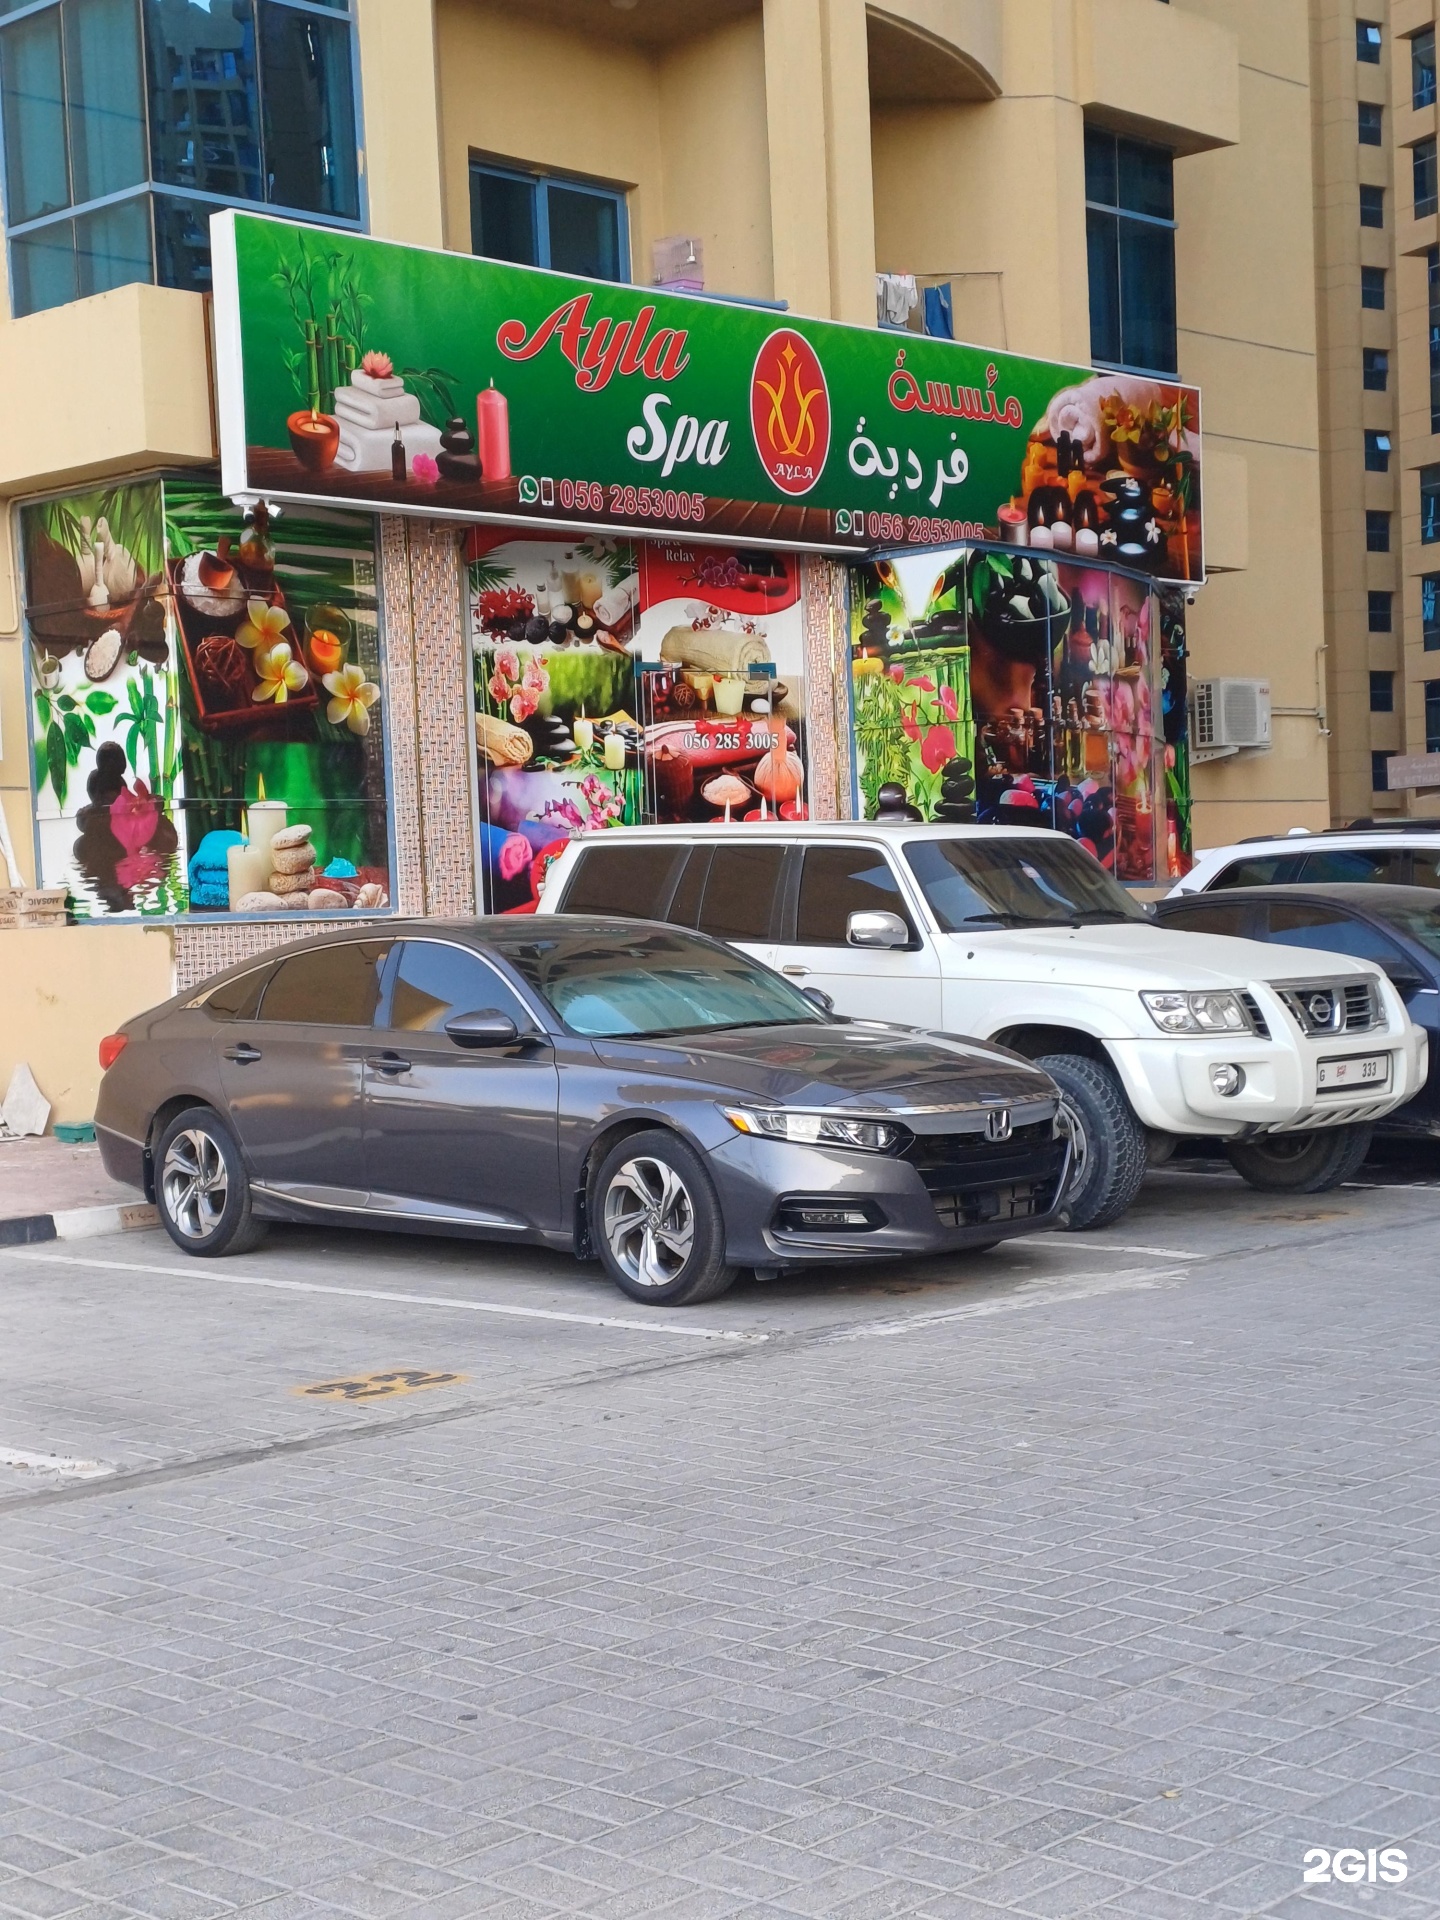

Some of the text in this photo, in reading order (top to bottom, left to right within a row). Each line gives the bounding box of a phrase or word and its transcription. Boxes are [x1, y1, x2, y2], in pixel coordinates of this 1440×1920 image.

[496, 292, 690, 392] Ayla
[626, 393, 731, 477] Spa
[773, 463, 814, 480] AYLA
[848, 416, 970, 508] فردية
[560, 478, 705, 522] 056 2853005
[868, 511, 984, 543] 056 2853005
[665, 549, 696, 562] Relax
[684, 733, 779, 749] 056 285 3005
[28, 897, 60, 906] MOSAIC
[1319, 1069, 1326, 1082] G
[1362, 1062, 1377, 1077] 333
